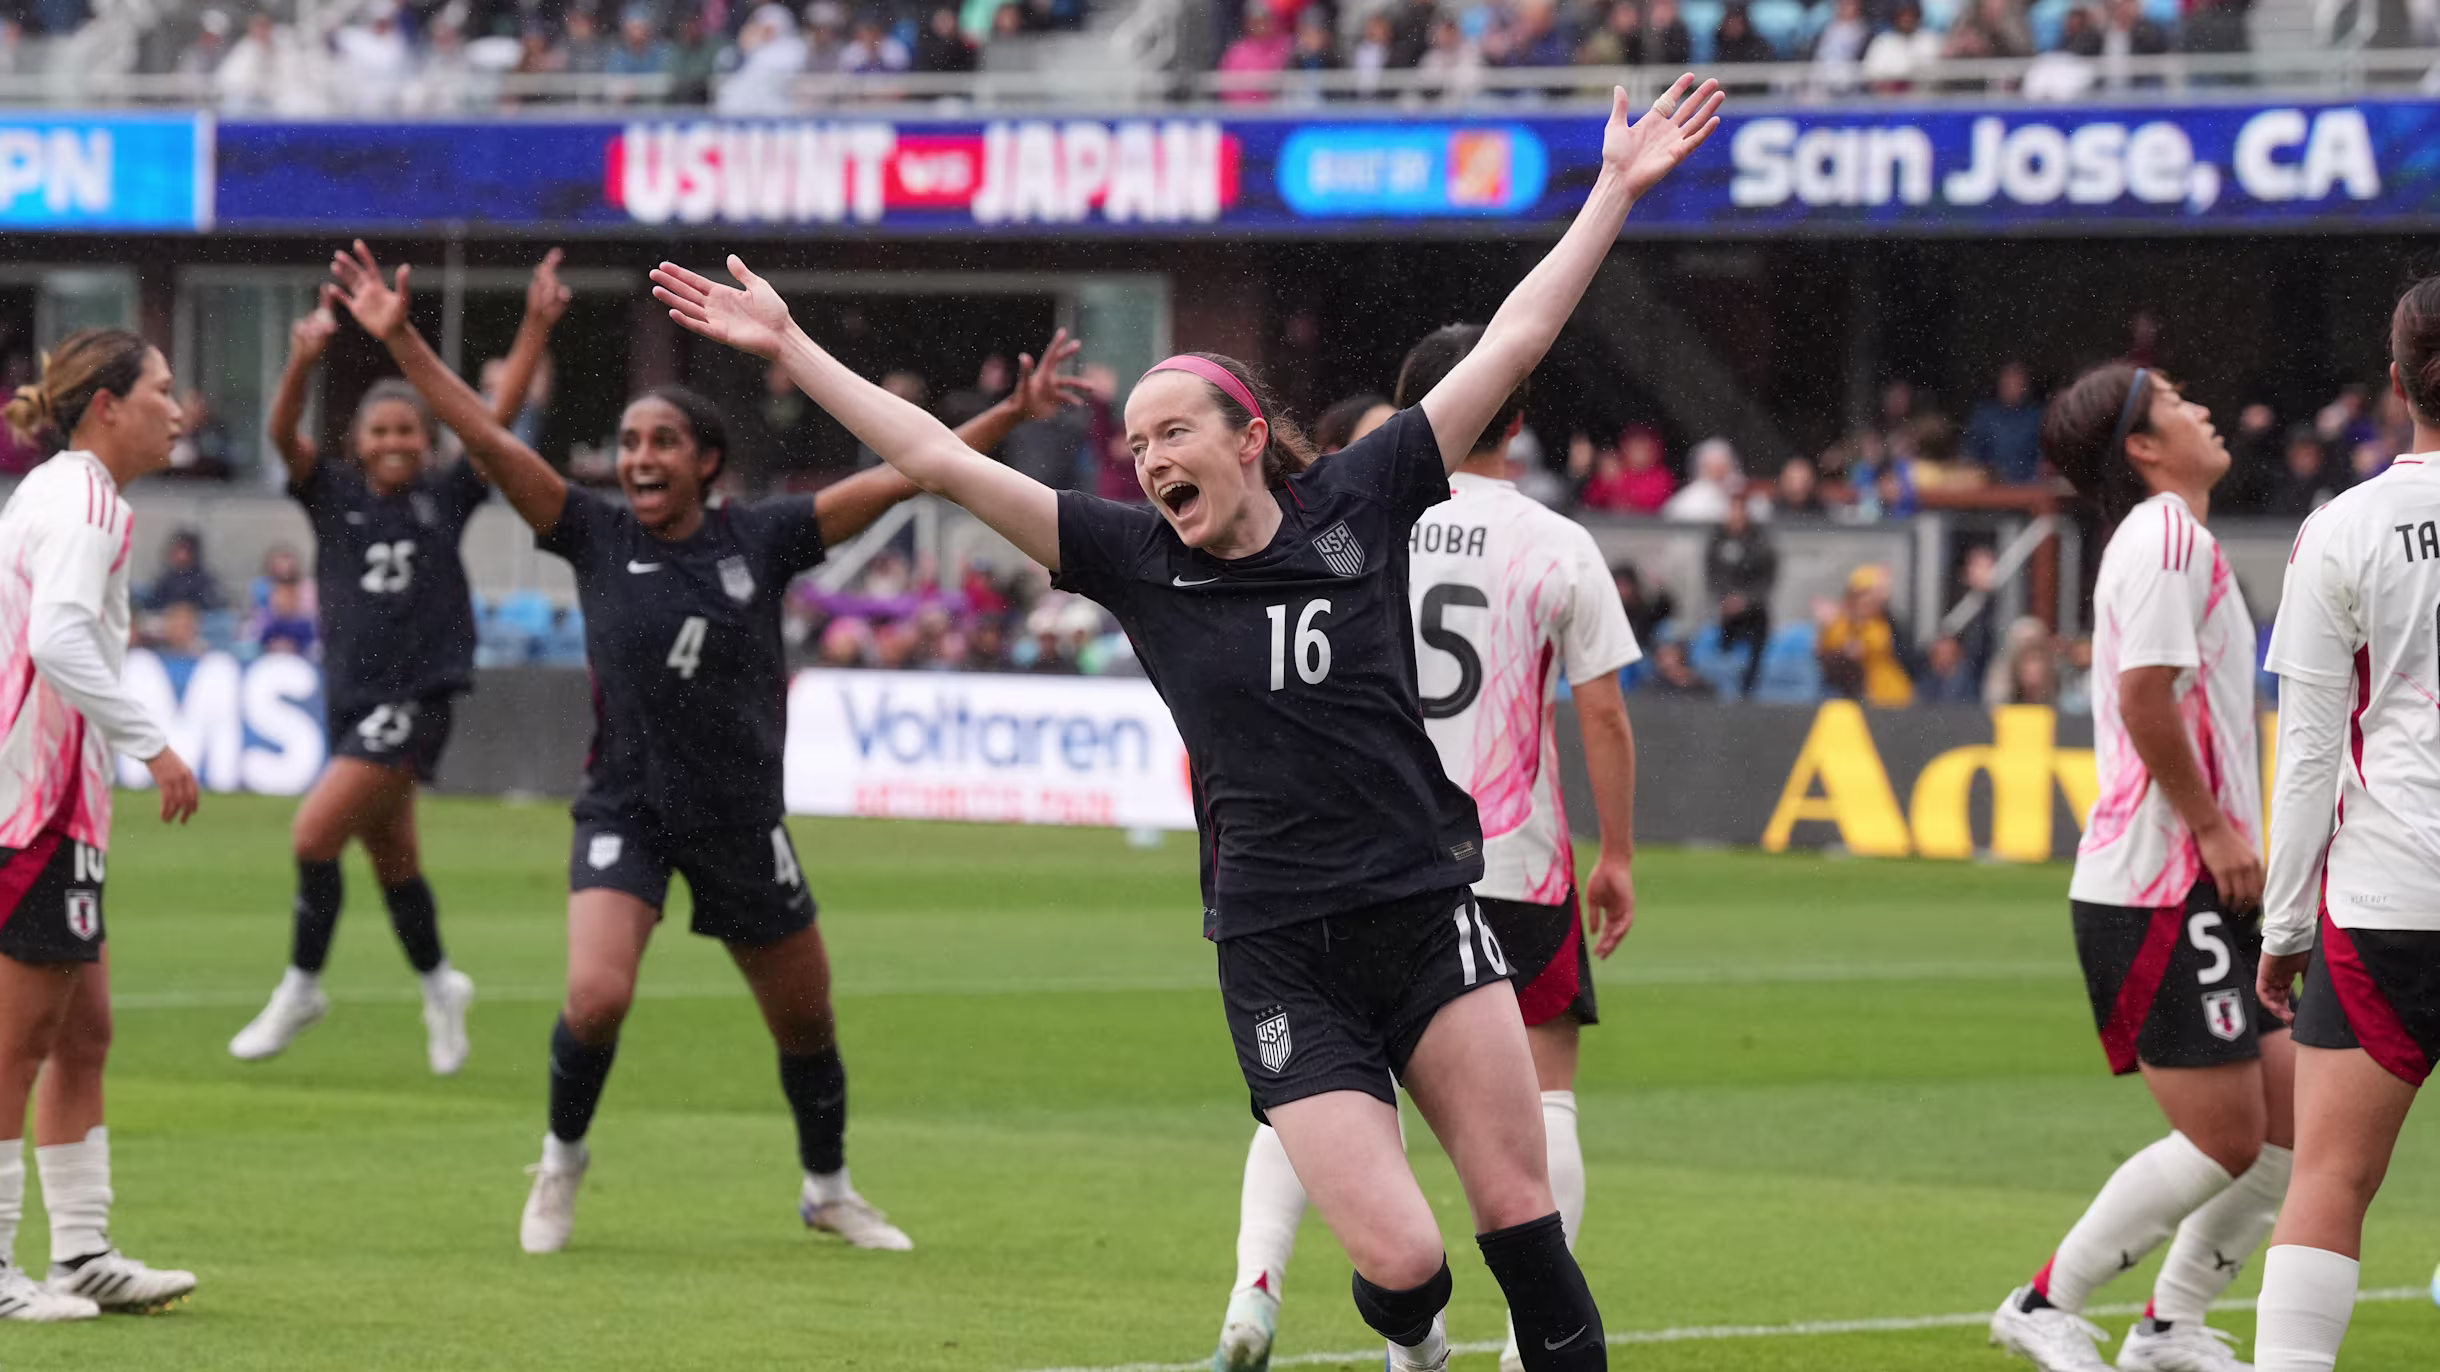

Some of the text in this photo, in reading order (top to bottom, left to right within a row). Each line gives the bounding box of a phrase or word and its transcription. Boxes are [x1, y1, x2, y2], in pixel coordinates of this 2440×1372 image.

[623, 121, 895, 222] USWNT
[971, 121, 1221, 222] JAPAN
[1729, 107, 2379, 214] San Jose, CA
[361, 539, 420, 593] 25
[1316, 525, 1349, 553] USA
[666, 615, 708, 680] 4
[1265, 597, 1332, 692] 16
[1419, 583, 1490, 720] 5
[842, 688, 1150, 771] Voltaren
[770, 825, 799, 887] 4
[1453, 901, 1508, 986] 16
[2187, 910, 2231, 985] 5
[1258, 1016, 1287, 1044] USA
